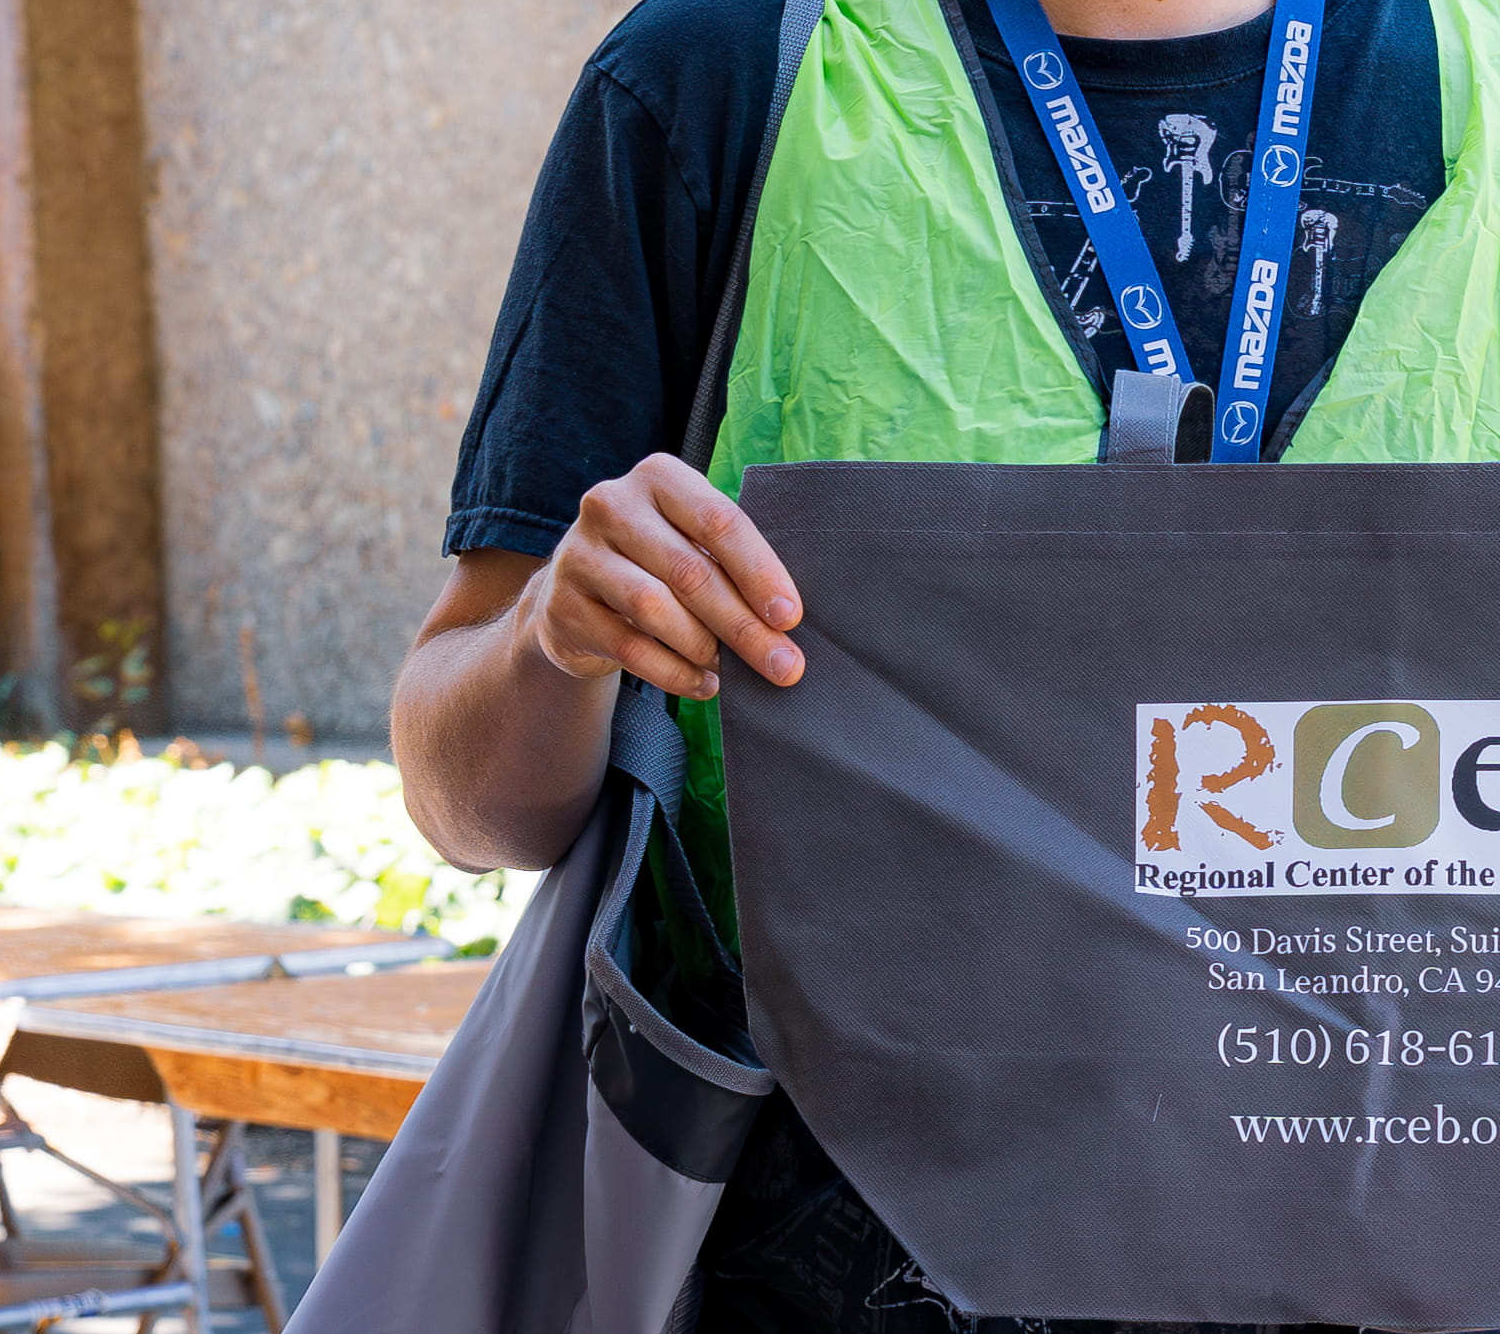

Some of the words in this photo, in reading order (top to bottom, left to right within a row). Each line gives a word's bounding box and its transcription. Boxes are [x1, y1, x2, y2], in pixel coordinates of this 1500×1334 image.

[1137, 862, 1275, 897] Regional
[1285, 860, 1395, 888] Center
[1404, 859, 1439, 886] of
[1445, 859, 1495, 886] the
[1185, 926, 1242, 953] 500
[1251, 927, 1336, 954] Davis
[1346, 926, 1442, 957] Street,
[1208, 962, 1266, 991] San
[1275, 966, 1409, 998] Leandro,
[1418, 967, 1468, 993] CA
[1217, 1022, 1332, 1070] (510)
